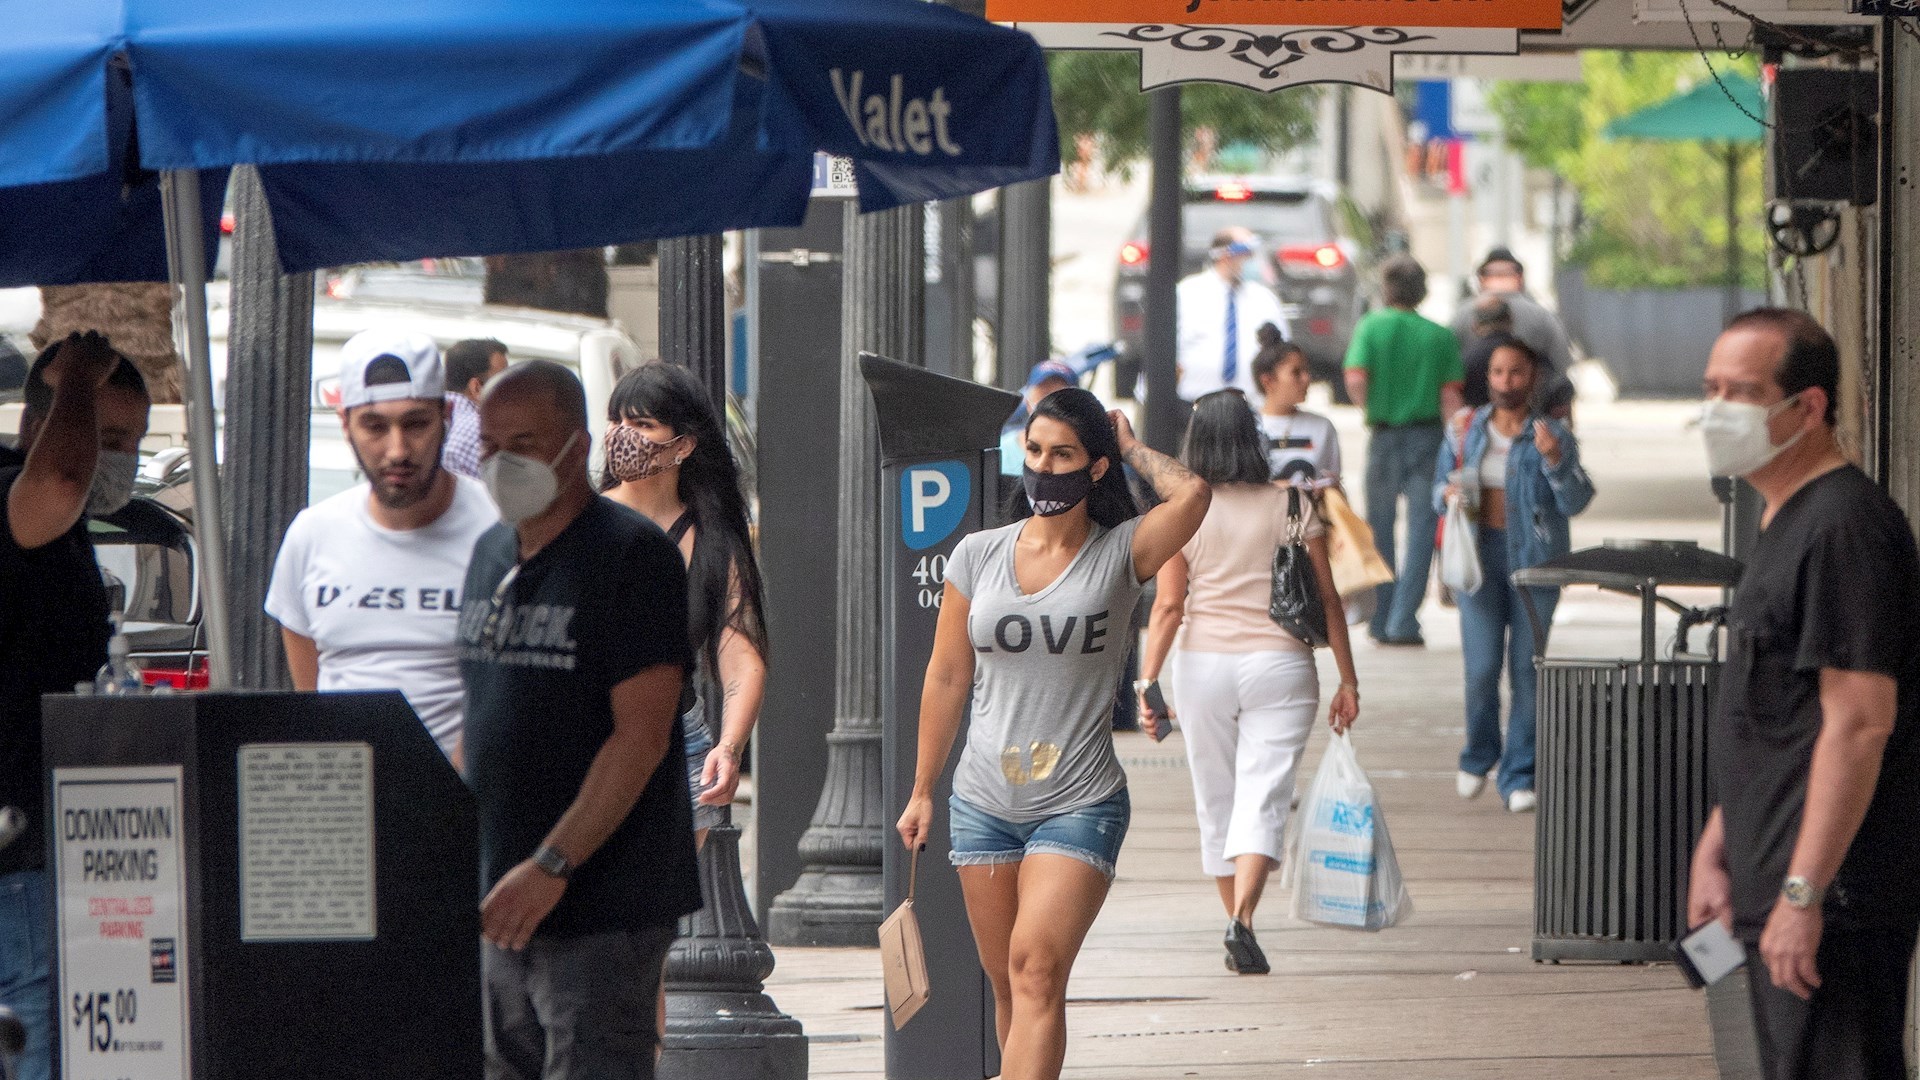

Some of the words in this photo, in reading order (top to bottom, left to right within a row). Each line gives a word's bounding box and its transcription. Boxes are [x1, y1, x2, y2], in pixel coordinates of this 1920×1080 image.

[829, 68, 963, 156] Valet
[911, 470, 951, 532] P
[316, 585, 462, 611] DESEL
[969, 610, 1109, 655] LOVE
[64, 807, 172, 841] DOWNTOWN
[83, 849, 158, 882] PARKING
